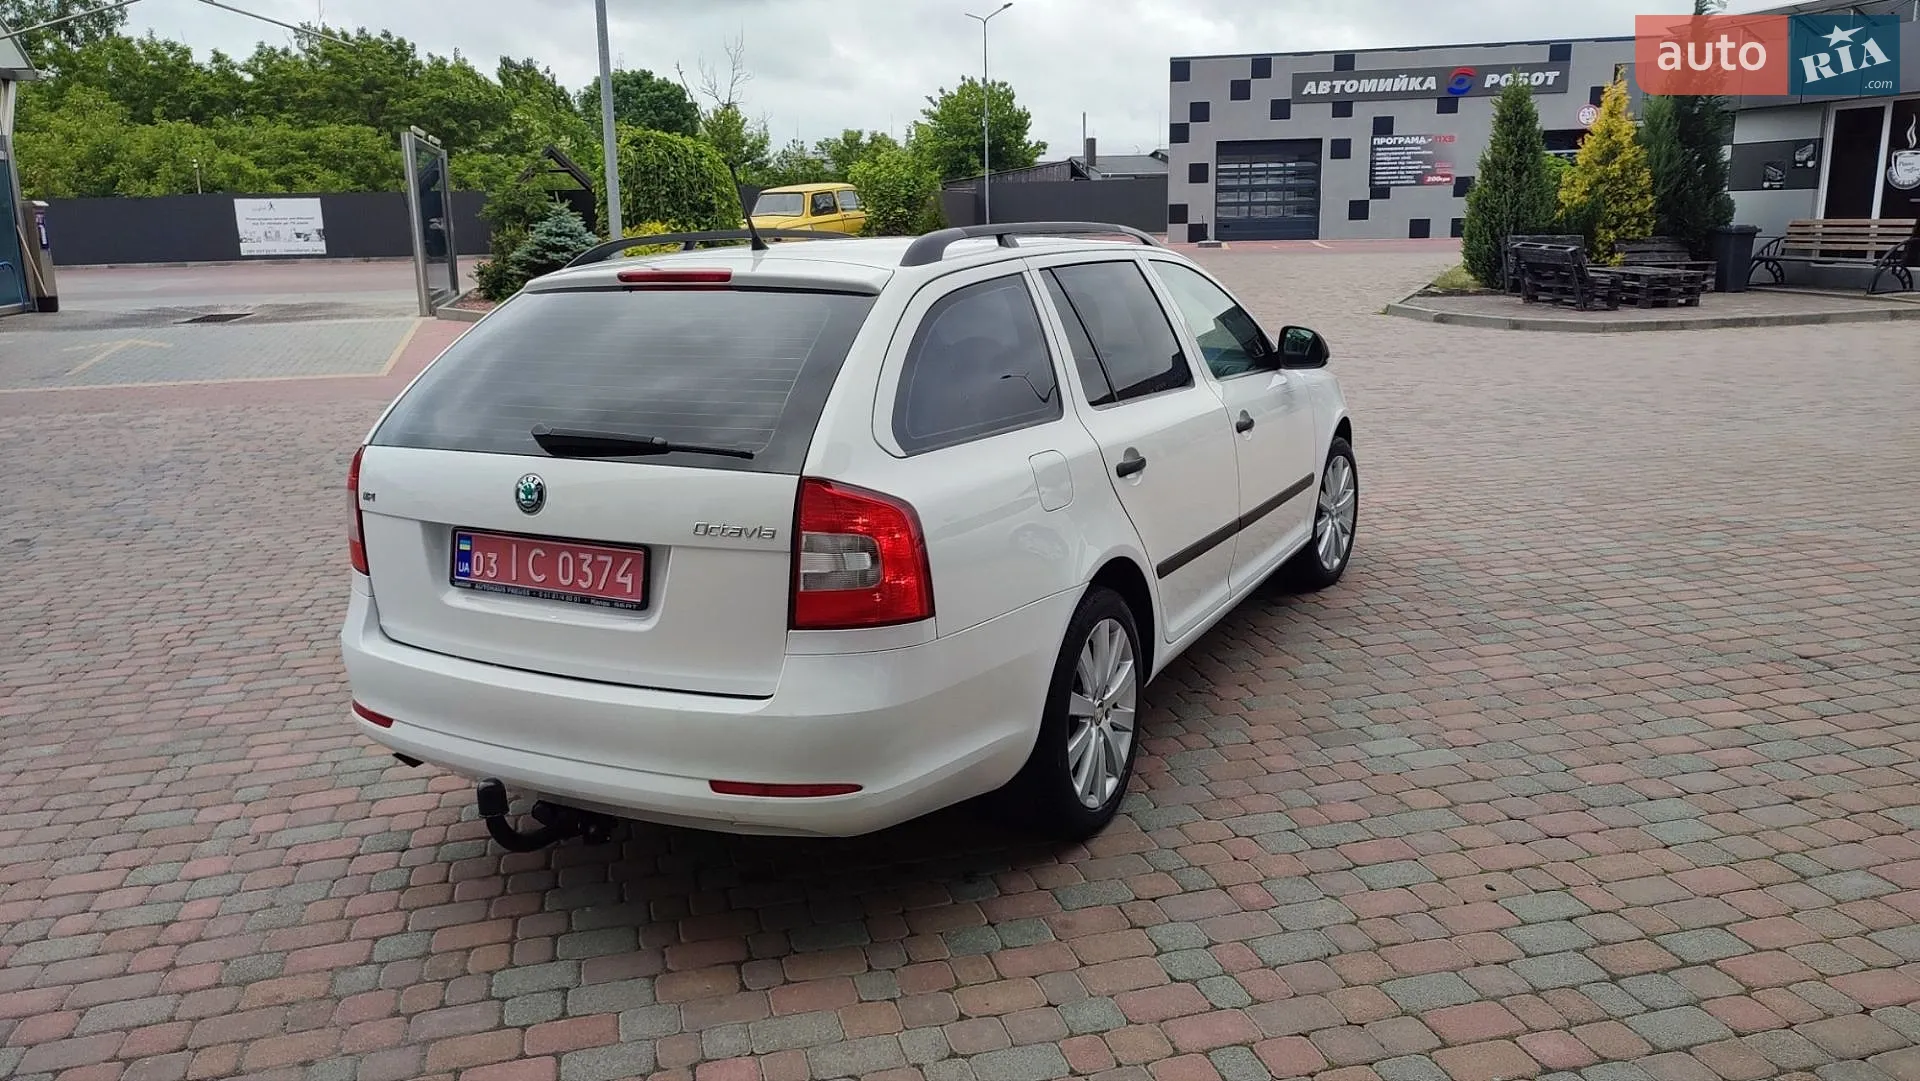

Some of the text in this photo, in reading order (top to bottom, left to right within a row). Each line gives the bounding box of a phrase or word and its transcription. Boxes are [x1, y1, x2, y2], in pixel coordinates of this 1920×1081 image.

[1302, 71, 1560, 96] АВТОМИЙКА РОБОТ
[1373, 135, 1426, 145] ПРОГРАМА
[693, 521, 777, 539] Octavia
[458, 561, 470, 573] UA
[472, 551, 498, 578] 03
[558, 550, 634, 593] 0374
